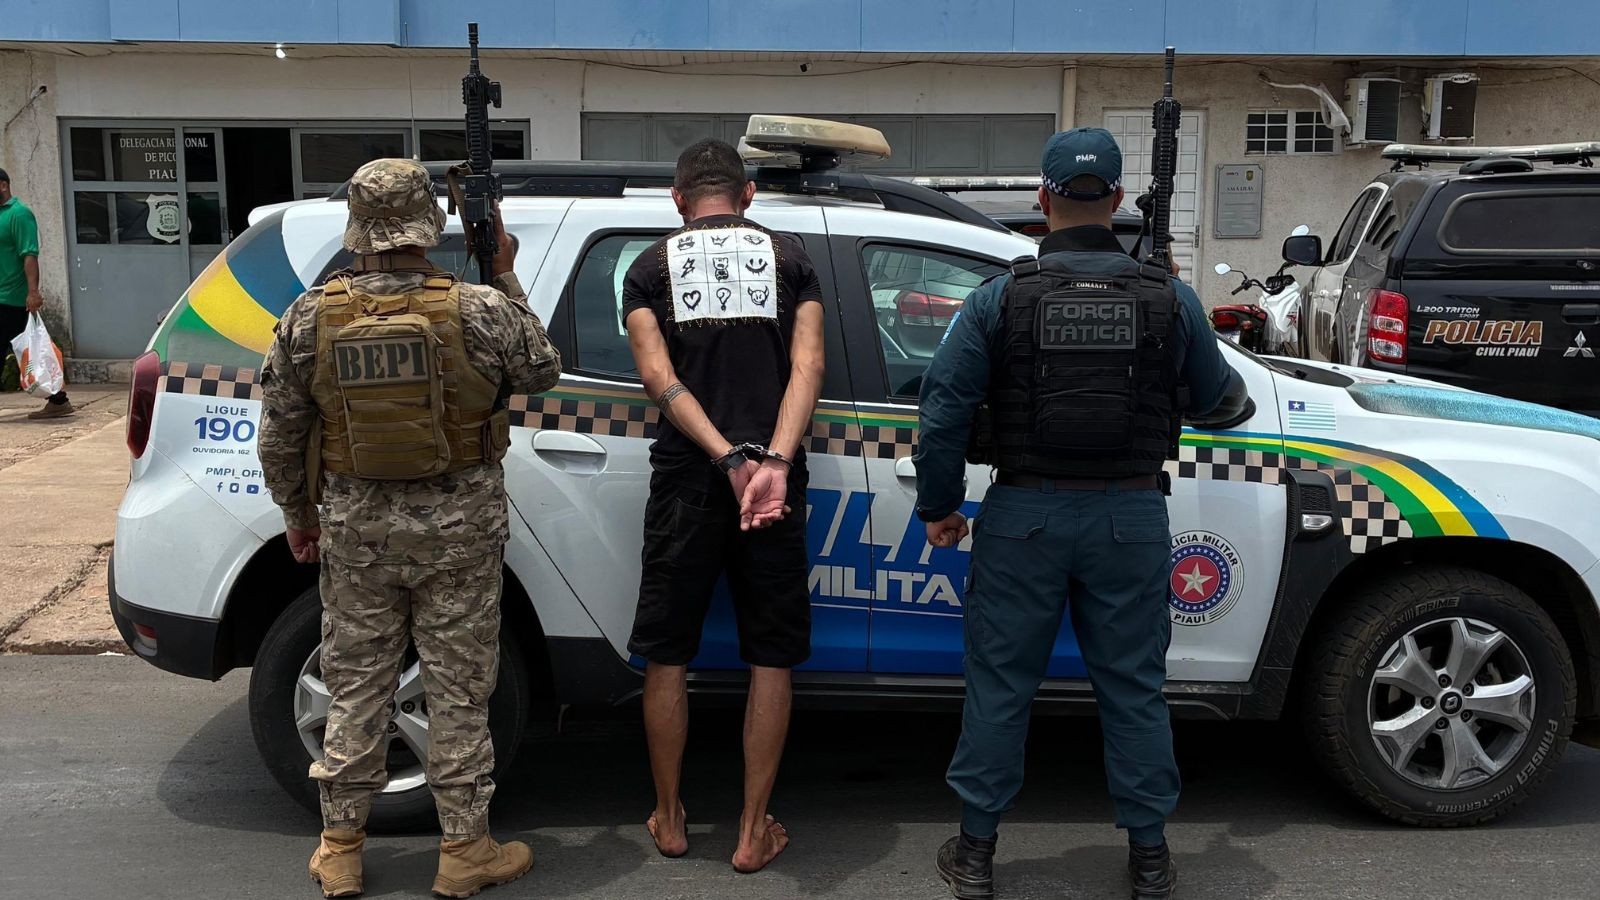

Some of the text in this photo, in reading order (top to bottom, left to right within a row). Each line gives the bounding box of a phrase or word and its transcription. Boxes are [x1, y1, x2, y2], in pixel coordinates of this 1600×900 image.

[120, 137, 165, 148] DELEGACIA
[145, 152, 157, 162] DE
[1075, 153, 1097, 163] PMPI
[1046, 303, 1131, 321] FORÇA
[1416, 305, 1480, 314] L200 TRITON
[1046, 322, 1131, 343] TÁTICA
[1423, 320, 1543, 345] POLÍCIA
[1475, 346, 1540, 358] CIVIL PIAUÍ
[336, 341, 426, 381] BEPI
[206, 405, 248, 417] LIGUE
[194, 417, 256, 442] 190
[1202, 534, 1239, 567] MILITAR
[1416, 597, 1460, 616] PRIME
[1173, 613, 1206, 624] PIAUÍ
